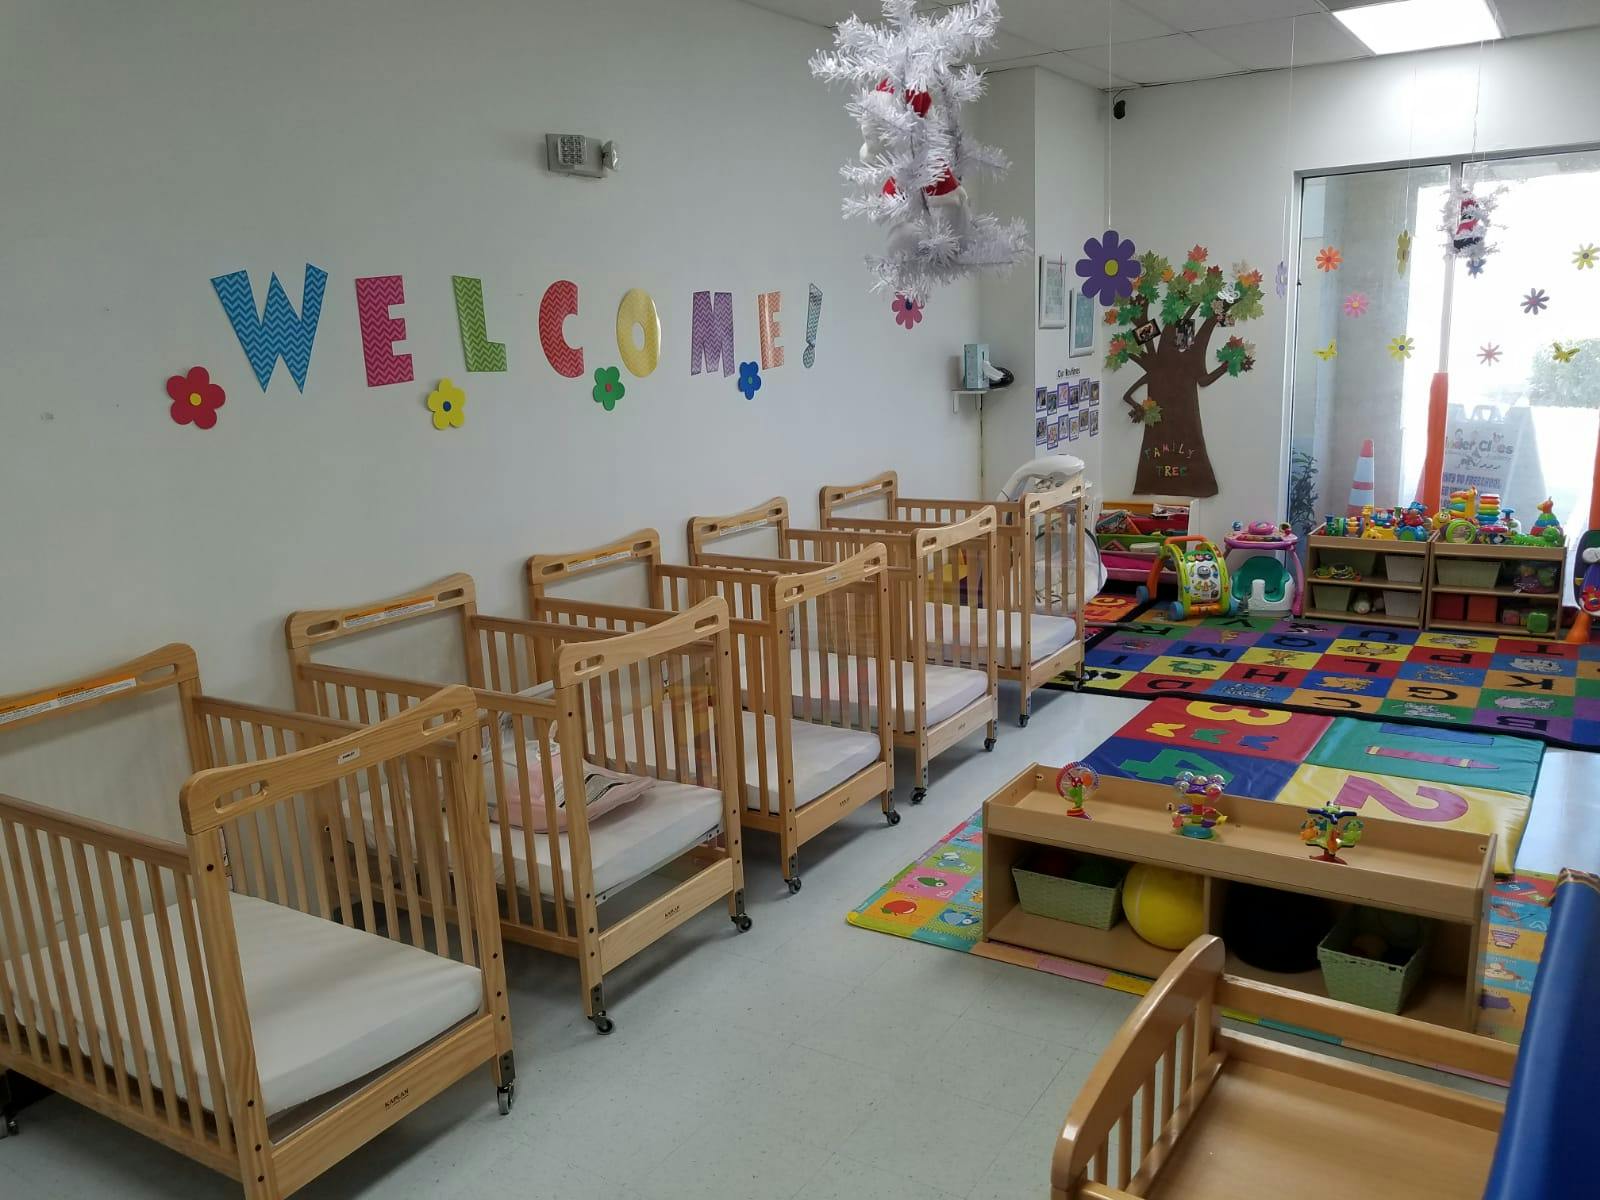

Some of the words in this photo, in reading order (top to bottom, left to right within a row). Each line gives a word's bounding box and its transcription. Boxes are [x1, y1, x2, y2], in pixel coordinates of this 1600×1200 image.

[210, 262, 822, 394] WELCOME!
[1143, 440, 1195, 464] FAMILY
[1155, 465, 1187, 478] TREE
[1334, 775, 1469, 822] 2
